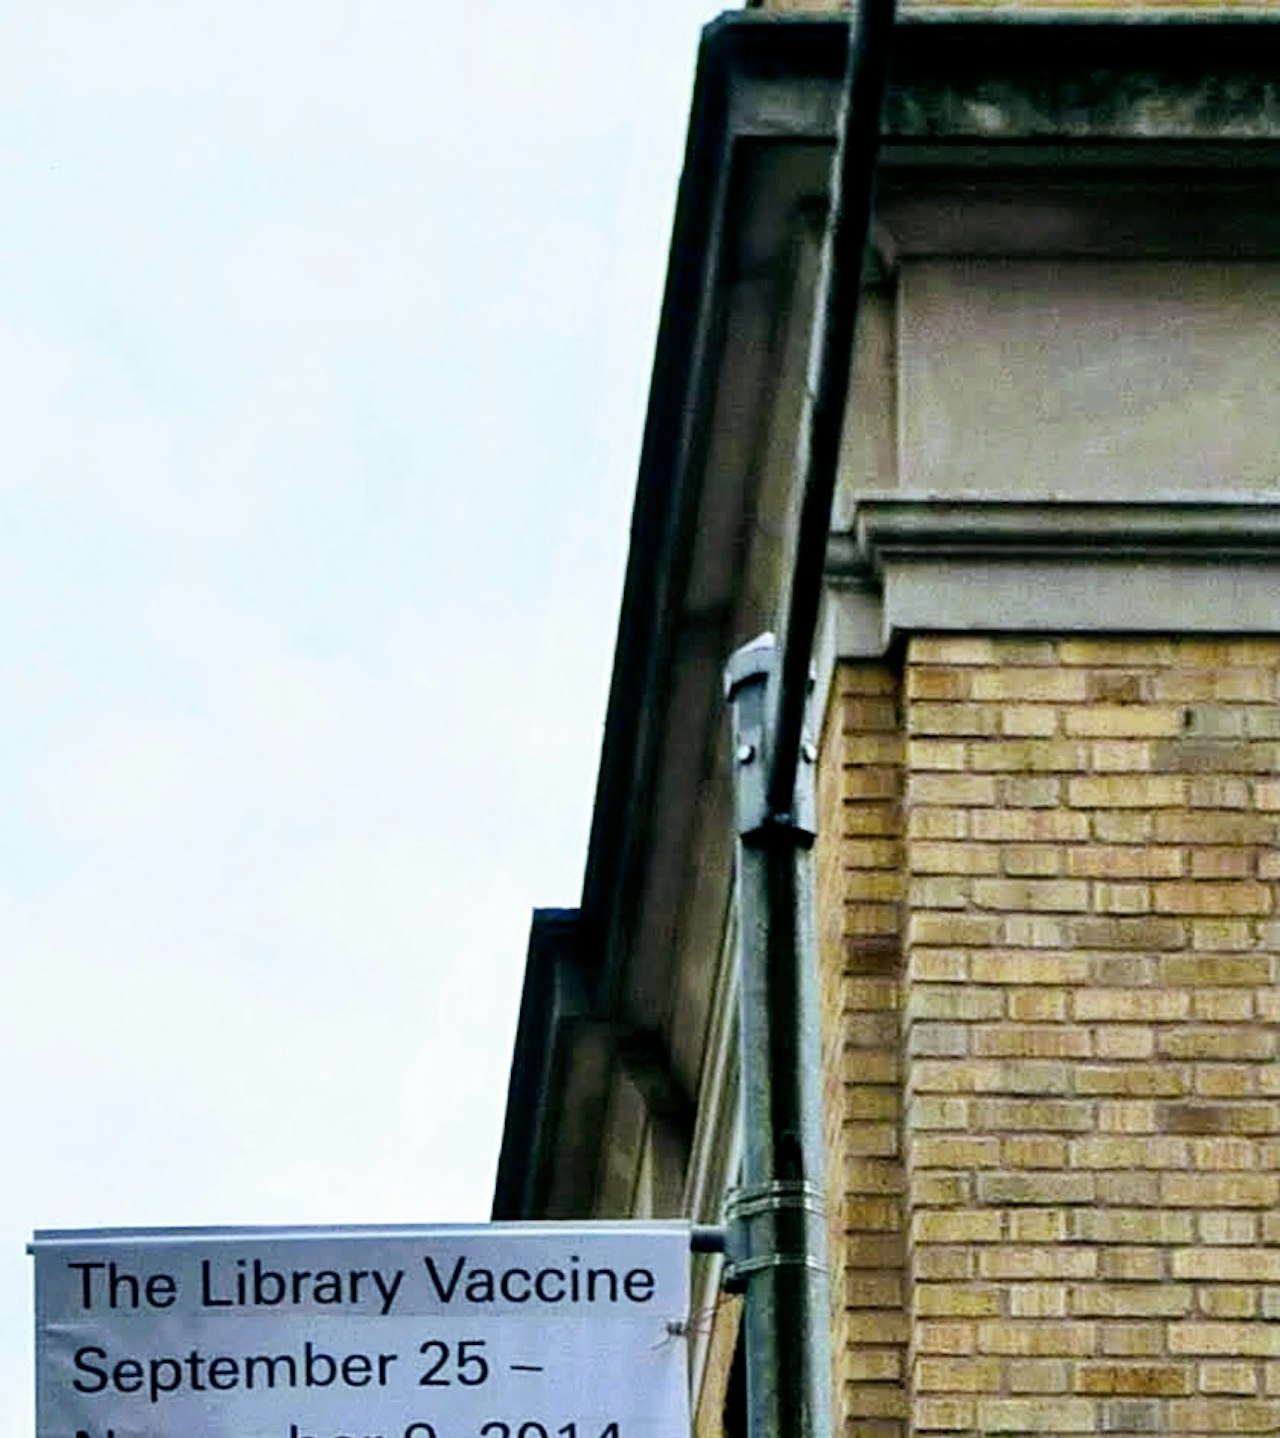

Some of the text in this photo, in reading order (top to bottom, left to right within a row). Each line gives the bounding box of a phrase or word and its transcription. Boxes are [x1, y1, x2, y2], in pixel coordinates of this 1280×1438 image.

[68, 1255, 656, 1314] The Library Vaccine
[71, 1342, 397, 1402] September
[418, 1340, 489, 1387] 25
